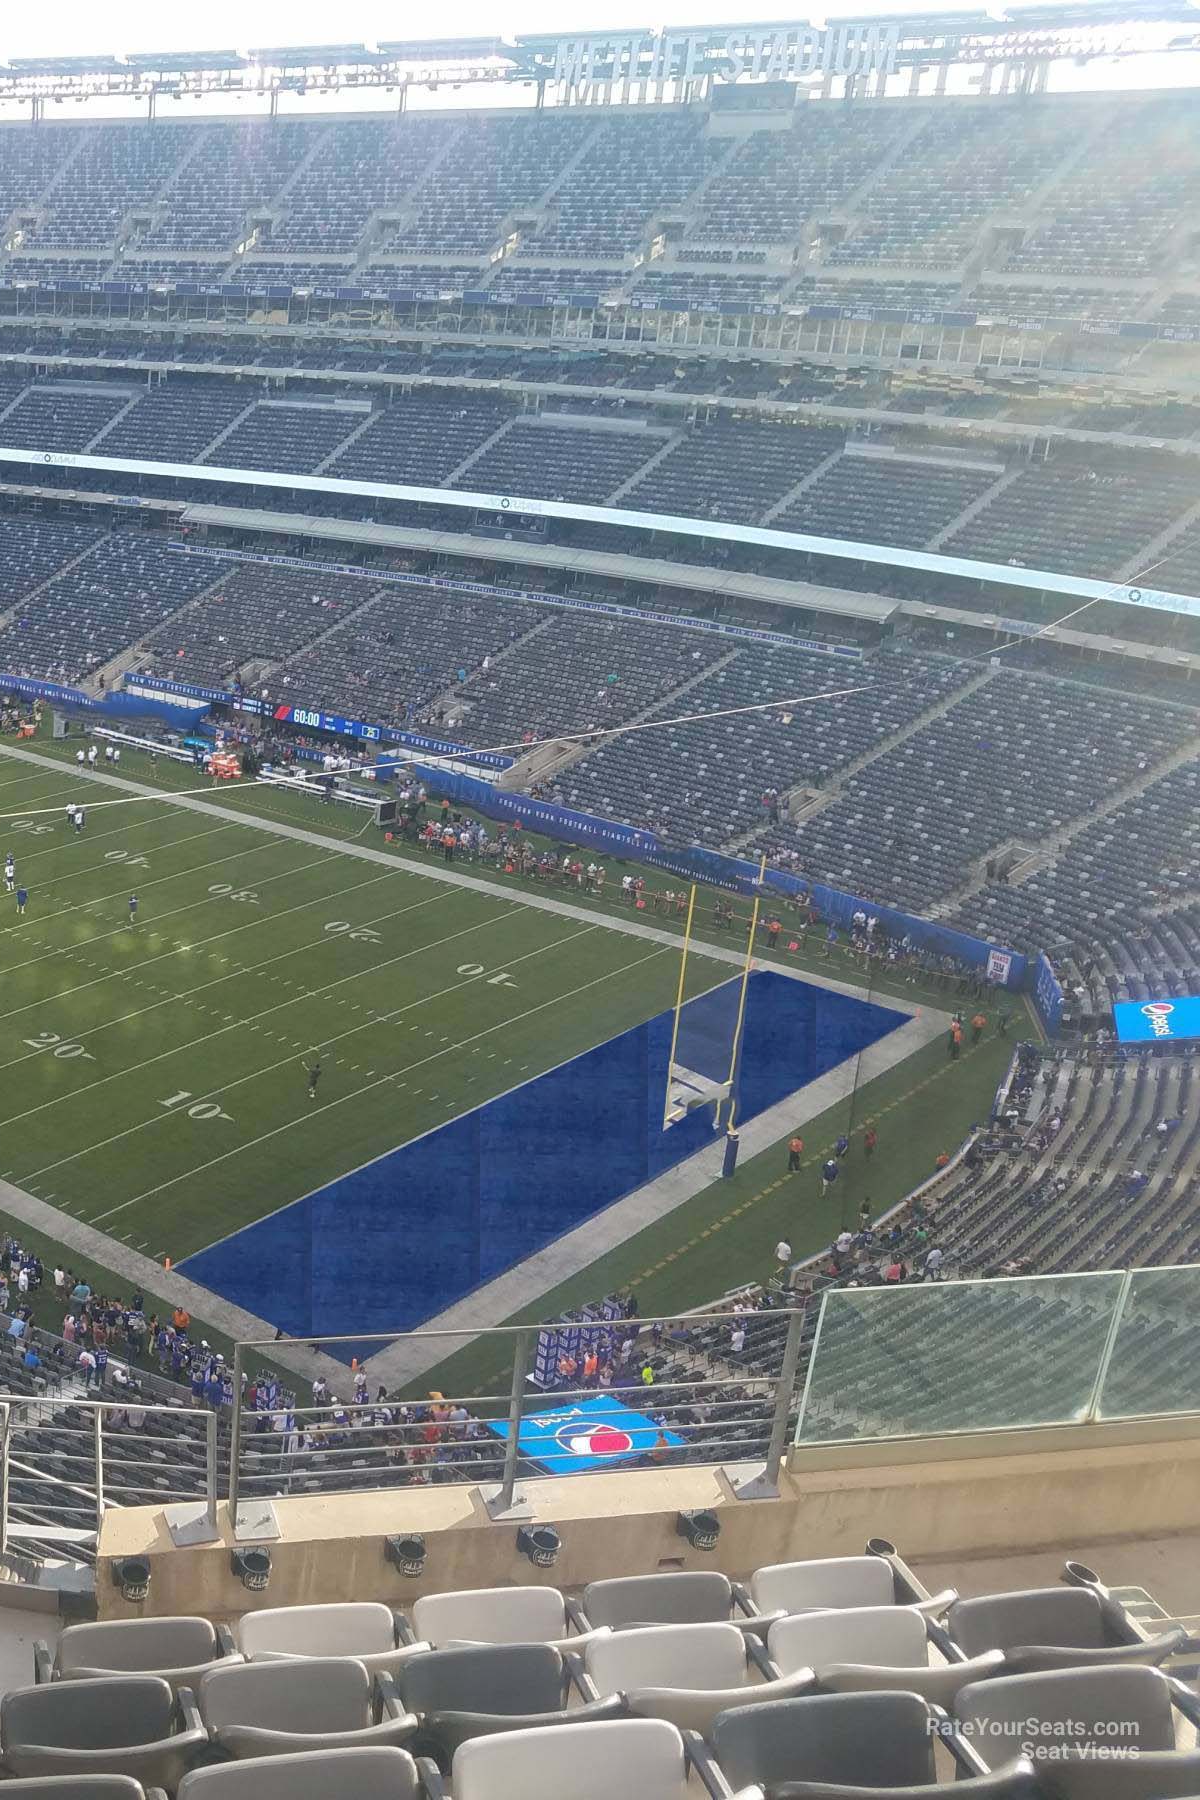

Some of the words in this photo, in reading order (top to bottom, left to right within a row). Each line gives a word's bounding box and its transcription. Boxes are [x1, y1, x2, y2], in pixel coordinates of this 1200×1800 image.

[554, 36, 709, 85] METLIFE
[719, 25, 900, 80] STADIUM
[131, 676, 144, 684] NEW
[293, 708, 320, 727] 60:00
[390, 732, 406, 742] NEW
[411, 736, 429, 747] YORK
[476, 752, 504, 766] GIANTS
[1147, 1014, 1174, 1037] pepsi
[23, 1032, 84, 1057] 20
[160, 1089, 220, 1119] 10
